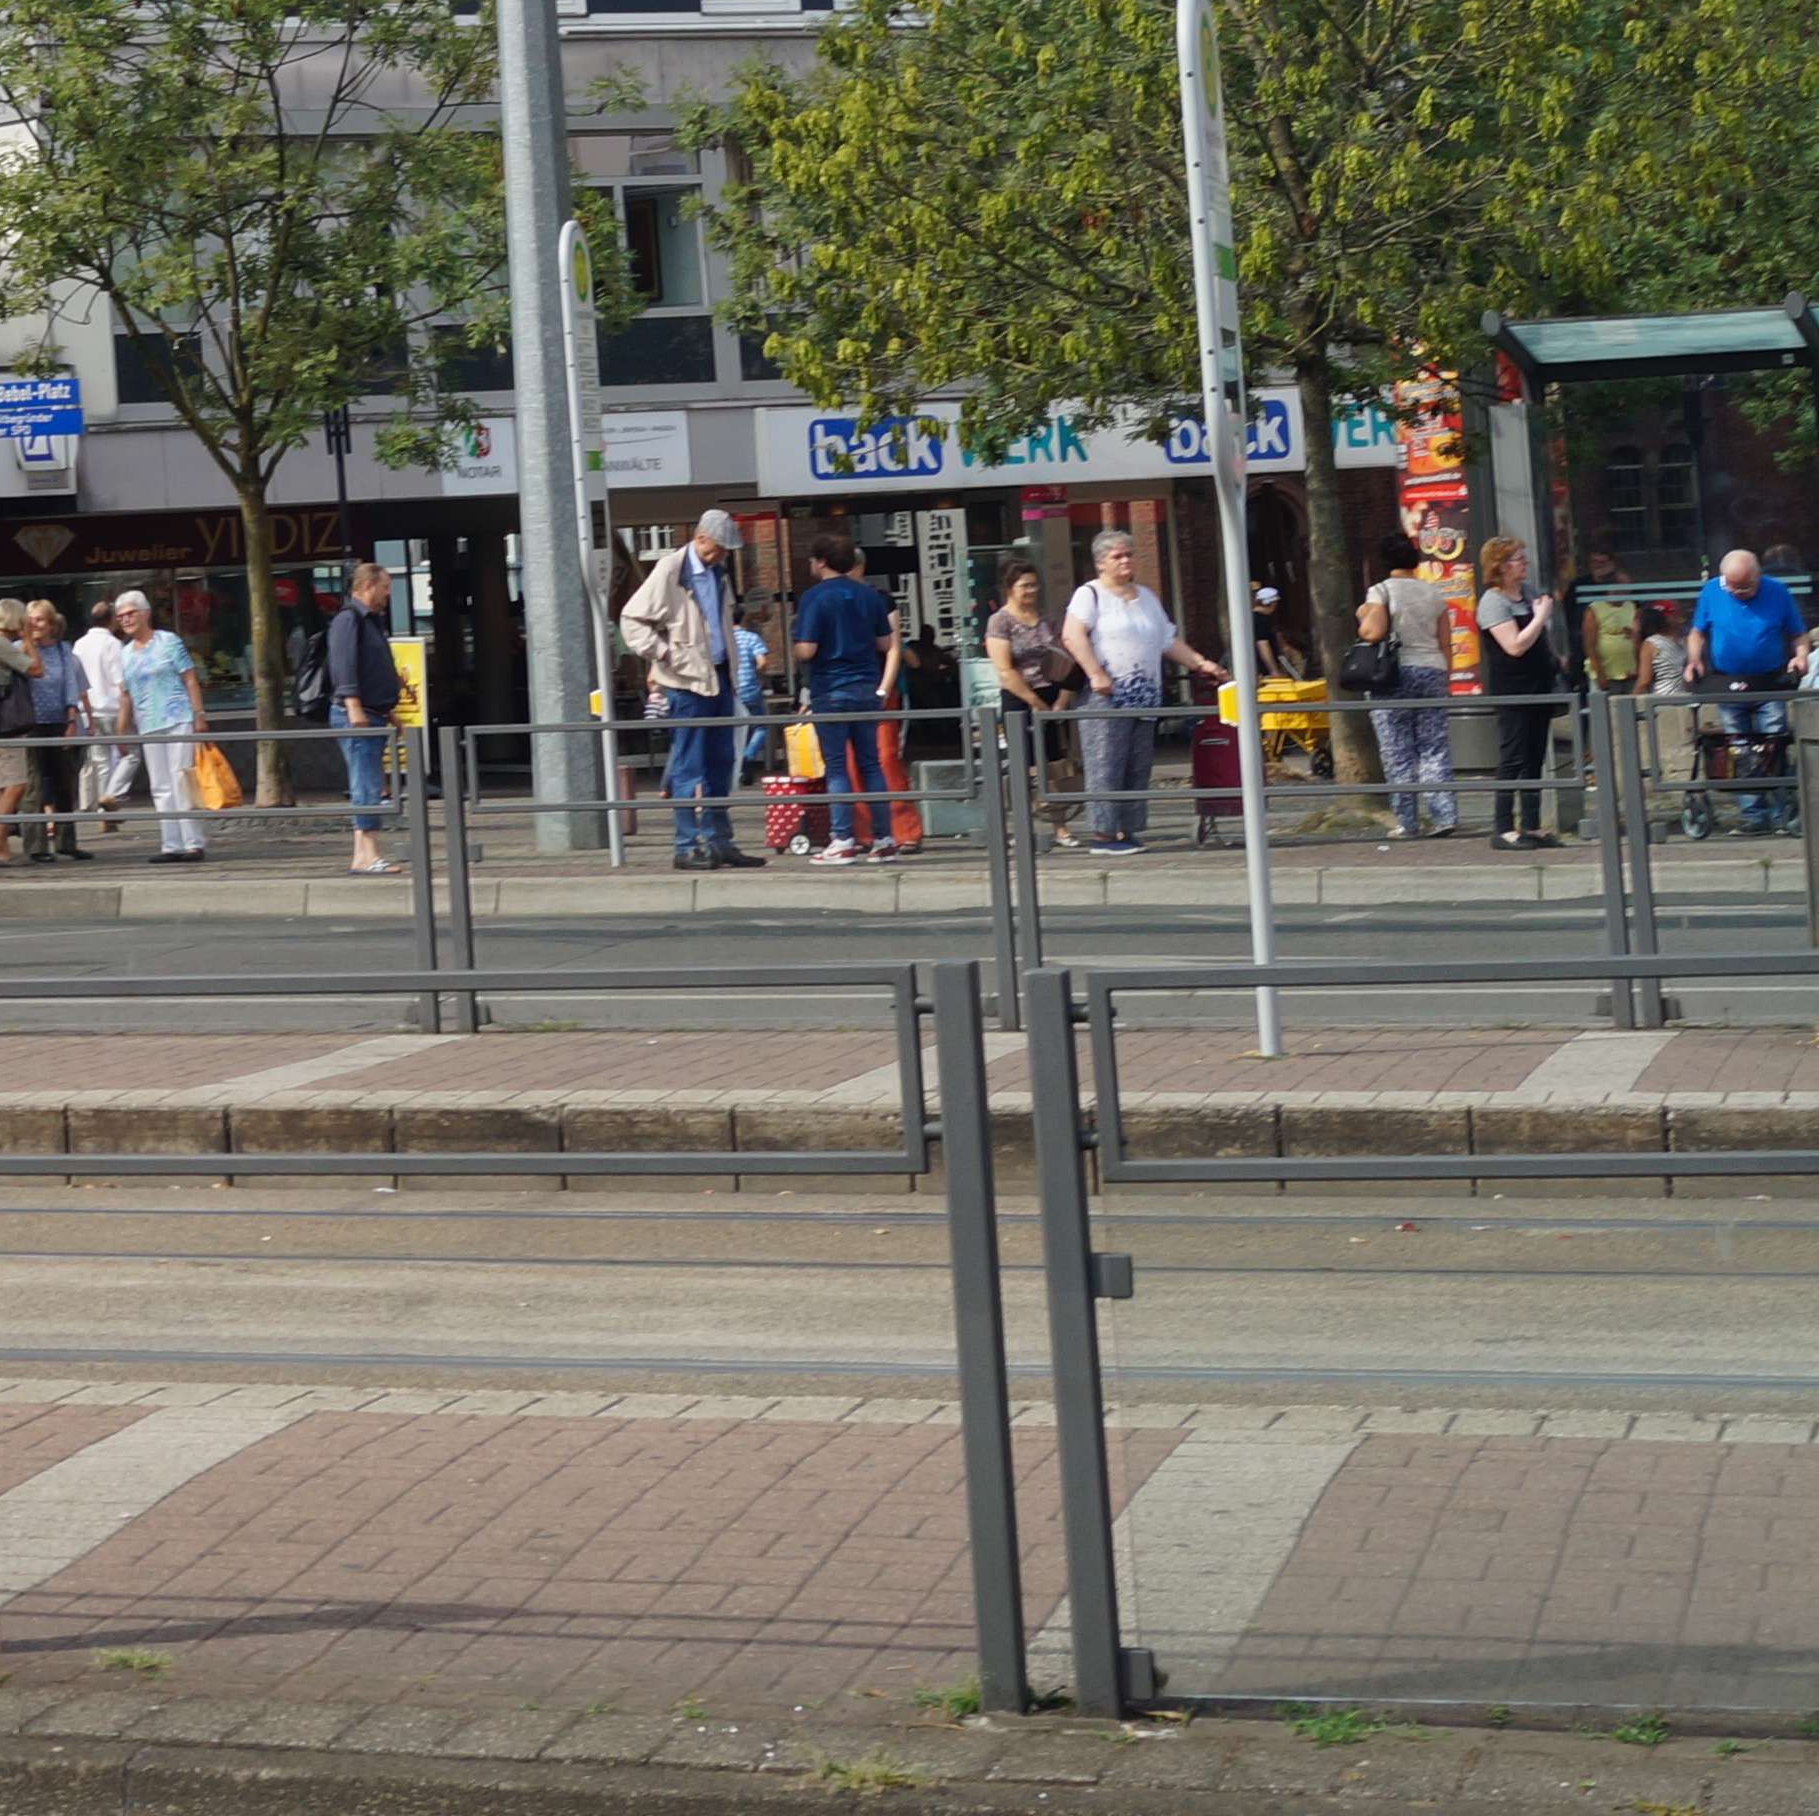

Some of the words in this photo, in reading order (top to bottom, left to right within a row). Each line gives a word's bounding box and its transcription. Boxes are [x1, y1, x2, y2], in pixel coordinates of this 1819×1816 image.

[10, 424, 32, 436] SPD
[814, 421, 939, 474] back
[960, 414, 1089, 468] ERK
[457, 465, 502, 479] NOTAR
[84, 544, 193, 565] Juwelier
[195, 512, 343, 564] YIDIZ
